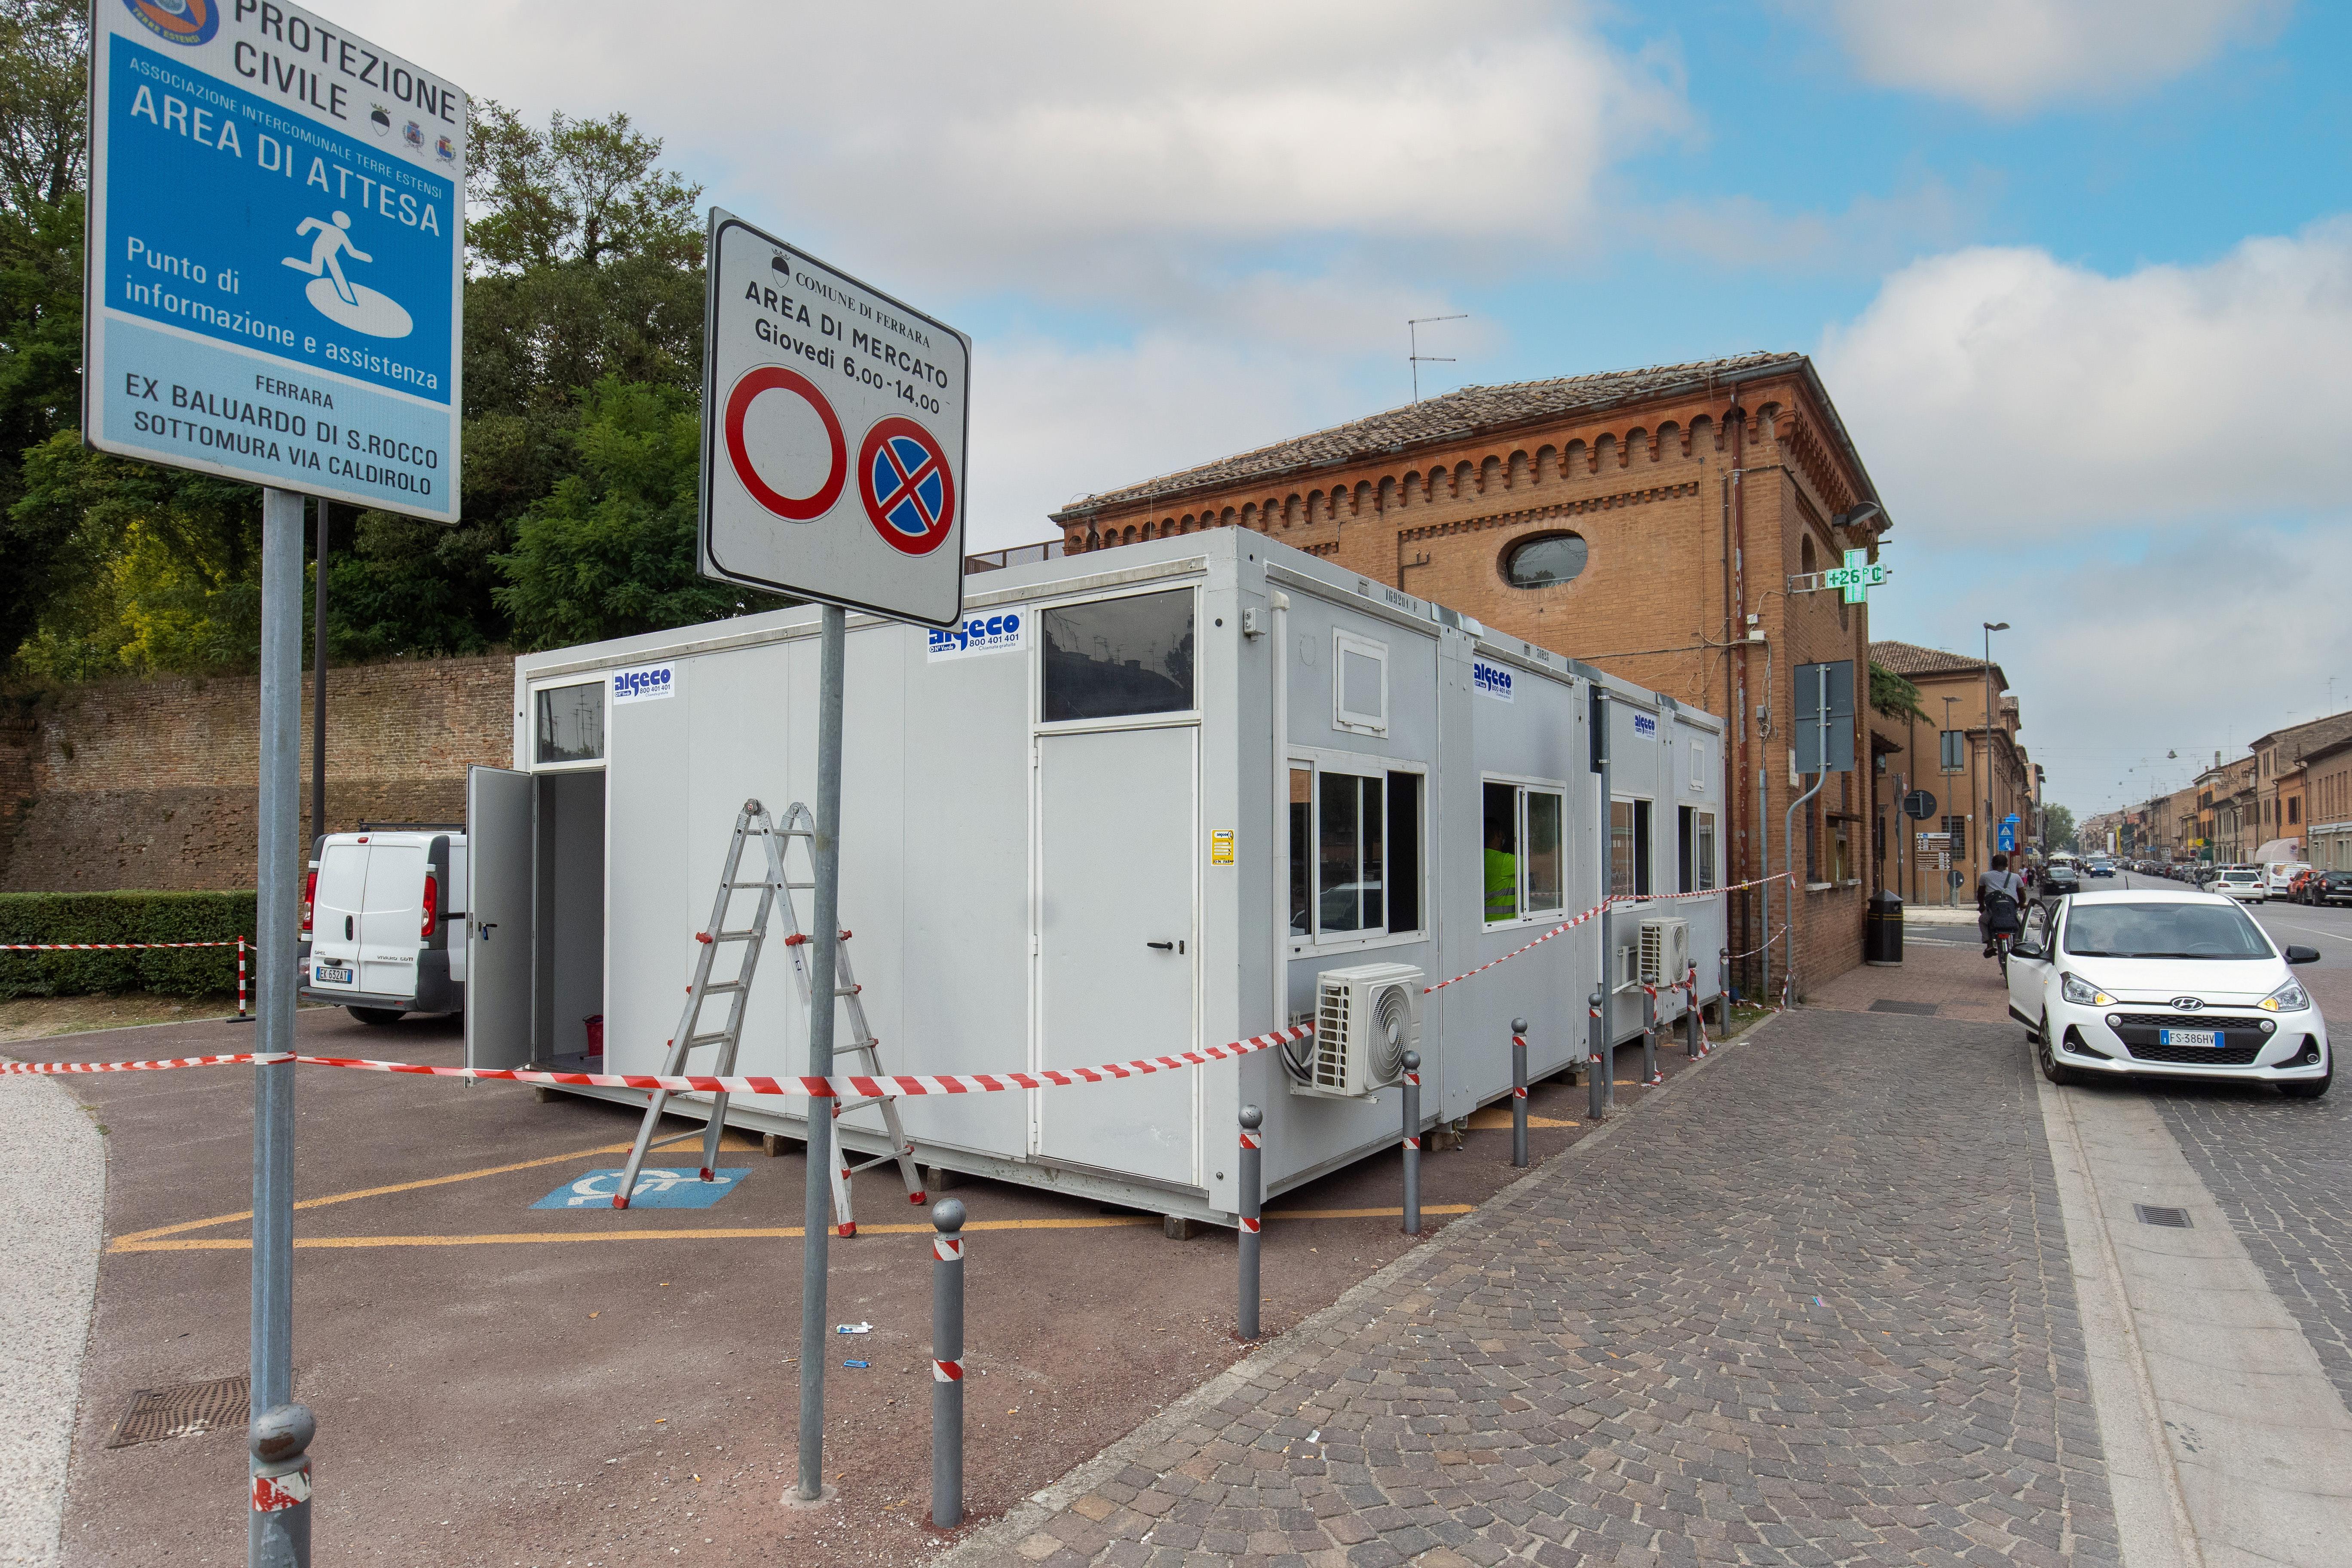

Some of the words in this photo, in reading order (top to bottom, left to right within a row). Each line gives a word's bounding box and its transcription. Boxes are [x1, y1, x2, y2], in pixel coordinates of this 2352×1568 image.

[235, 41, 347, 120] CIVILE
[236, 0, 456, 125] PROTEZIONE
[130, 57, 237, 113] ASSOCIAZIONE
[242, 104, 351, 161] INTERCOMUNALE
[356, 152, 392, 178] TERRE
[396, 170, 442, 199] ESTENSI
[130, 84, 242, 158] AREA
[258, 133, 292, 177] DI
[306, 156, 440, 236] ATTESA
[127, 236, 207, 284] Punto
[217, 269, 239, 294] di
[126, 275, 295, 347] informazione
[304, 336, 316, 353] e
[325, 340, 438, 390] assistenza
[745, 280, 811, 328] AREA
[821, 313, 842, 341] DI
[853, 328, 948, 389] MERCATO
[755, 318, 834, 369] Giovedi
[796, 272, 855, 311] COMUNE
[860, 303, 872, 320] DI
[876, 310, 931, 349] FERRARA
[126, 373, 159, 401] EX
[172, 384, 306, 437] BALUARDO
[317, 422, 337, 446] DI
[347, 431, 438, 469] S.ROCCO
[256, 374, 334, 410] FERRARA
[134, 411, 280, 462] SOTTOMURA
[288, 447, 321, 471] VIA
[328, 456, 431, 495] CALDIROLO
[969, 638, 986, 647] 800
[988, 636, 1002, 644] 401
[1004, 633, 1019, 643] 401
[1474, 663, 1512, 692] algeco
[615, 668, 671, 697] algeco
[1635, 714, 1655, 735] algeco
